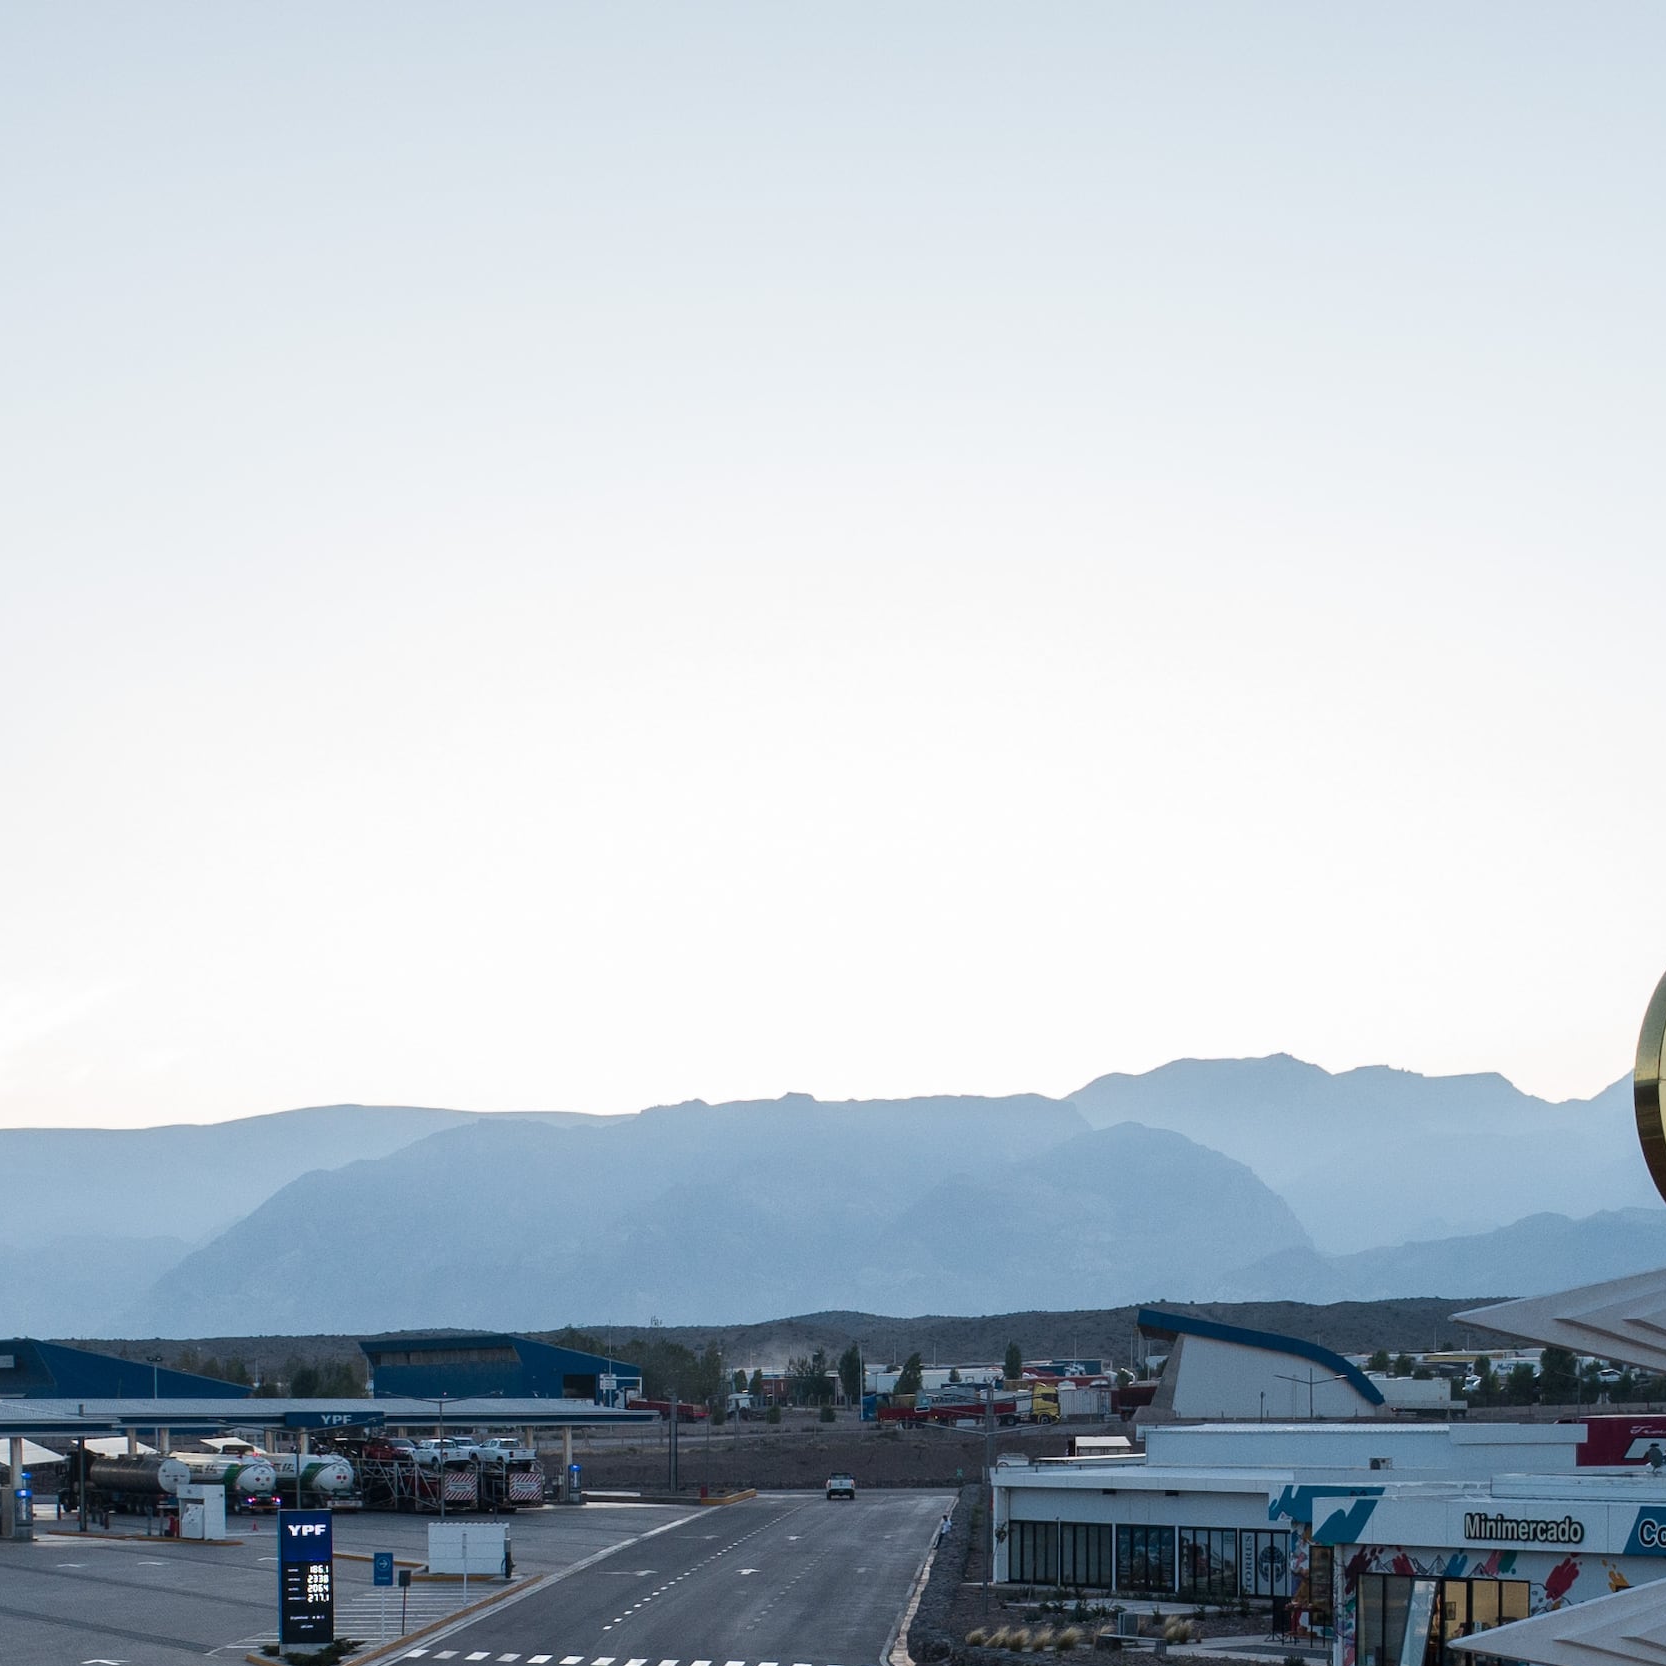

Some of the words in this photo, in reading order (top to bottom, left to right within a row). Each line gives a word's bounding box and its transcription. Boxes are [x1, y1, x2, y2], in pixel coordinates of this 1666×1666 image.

[321, 1415, 352, 1425] YPF
[288, 1524, 326, 1536] YPF
[1464, 1513, 1585, 1545] Minimercado
